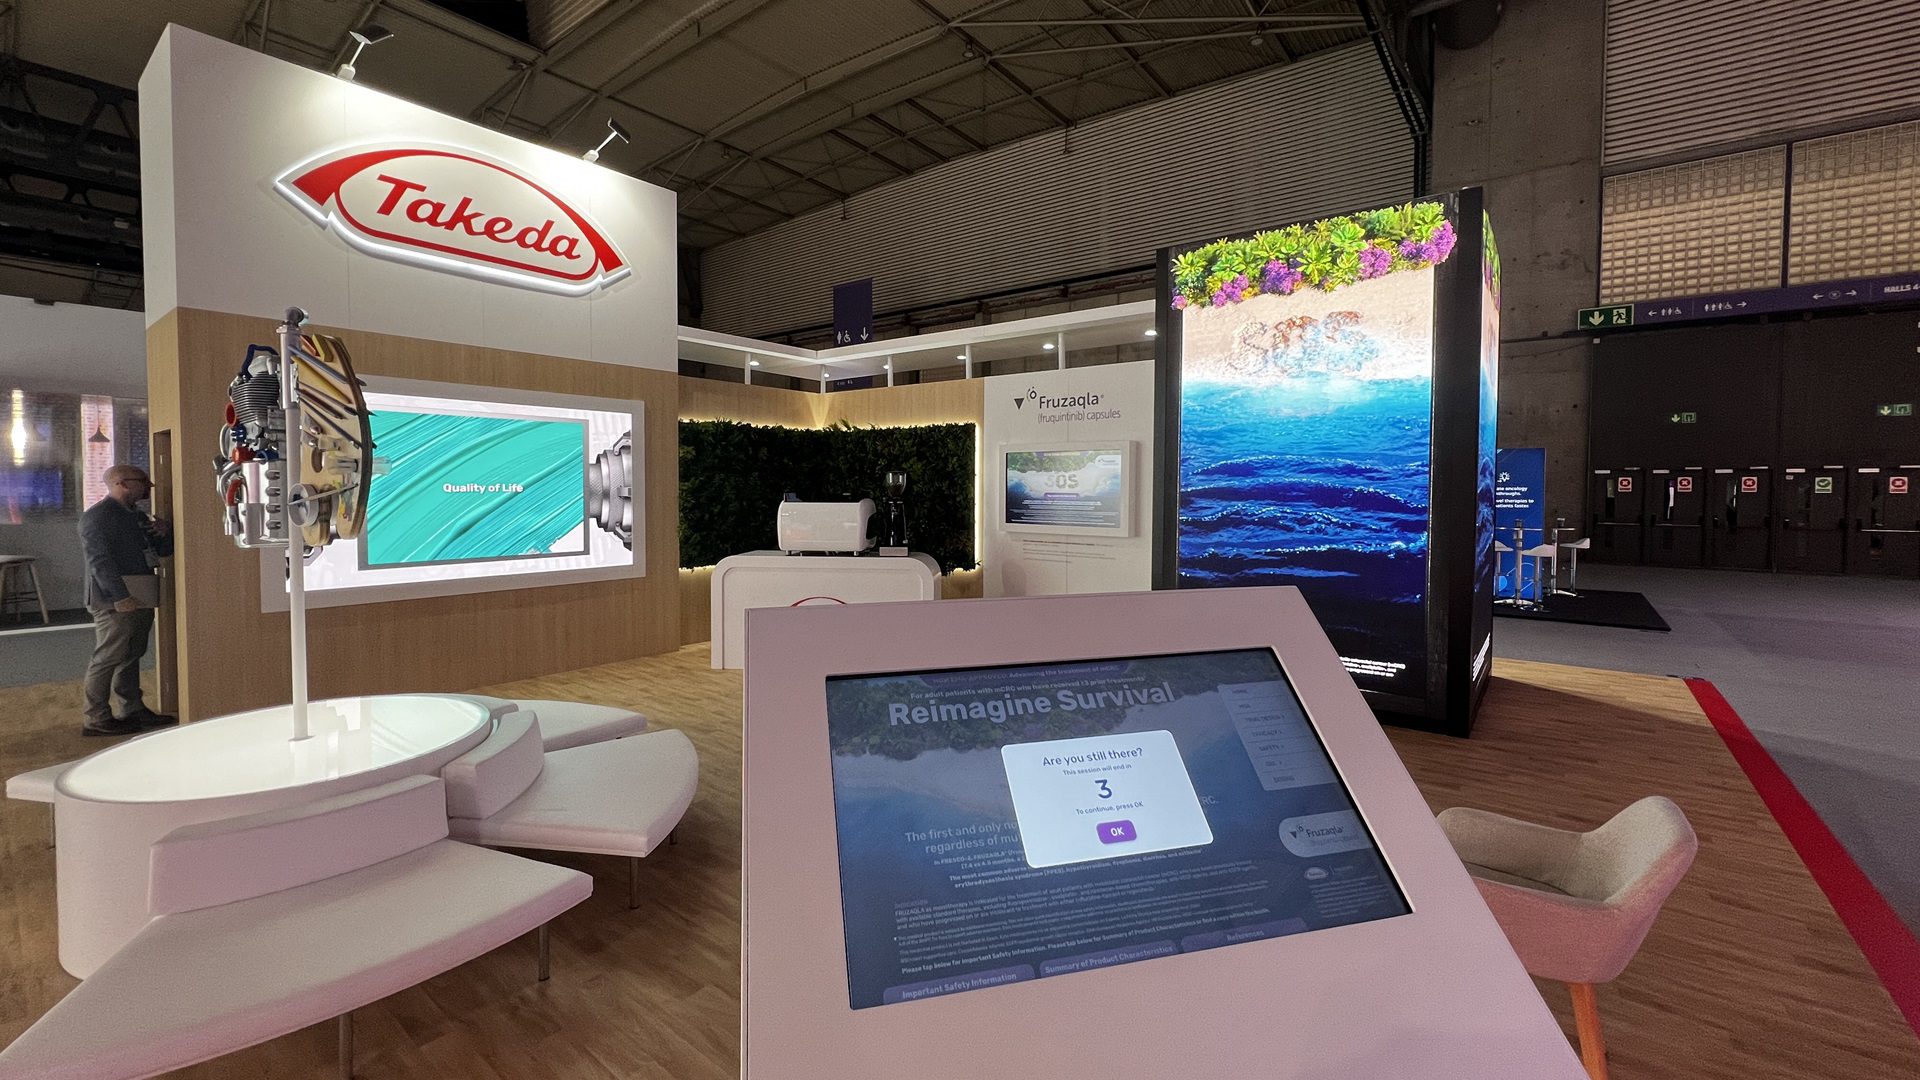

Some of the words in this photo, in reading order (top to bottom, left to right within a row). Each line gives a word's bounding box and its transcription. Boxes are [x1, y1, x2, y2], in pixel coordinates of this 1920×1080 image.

[376, 174, 581, 260] Takeda
[1883, 284, 1911, 293] HALLS
[1038, 410, 1085, 424] (fruquintinib)
[1087, 409, 1121, 421] capsules
[442, 483, 486, 495] Quality
[488, 482, 500, 493] of
[502, 482, 524, 493] Life
[888, 694, 1051, 725] Reimagine
[1056, 682, 1176, 711] Survival
[1040, 756, 1063, 766] Are
[1063, 756, 1085, 766] you
[1085, 750, 1107, 762] still
[1107, 747, 1145, 759] there?
[1061, 768, 1077, 776] This
[1076, 766, 1101, 774] session
[1100, 764, 1113, 772] will
[1112, 763, 1126, 771] end
[1092, 777, 1115, 800] 3
[1074, 808, 1085, 816] To
[1084, 805, 1116, 815] continue,
[1114, 803, 1134, 812] press
[1133, 800, 1145, 809] OK
[904, 831, 927, 842] The
[928, 827, 953, 839] first
[954, 824, 976, 836] and
[977, 822, 1001, 833] only
[1109, 826, 1125, 837] OK
[924, 839, 985, 854] regardless
[986, 834, 1000, 846] of
[1043, 962, 1080, 973] Summary
[1079, 959, 1089, 967] of
[1088, 954, 1119, 965] Product
[1117, 946, 1174, 960] Characteristics
[901, 984, 943, 998] Important
[943, 980, 971, 991] Safety
[970, 973, 1017, 986] Information
